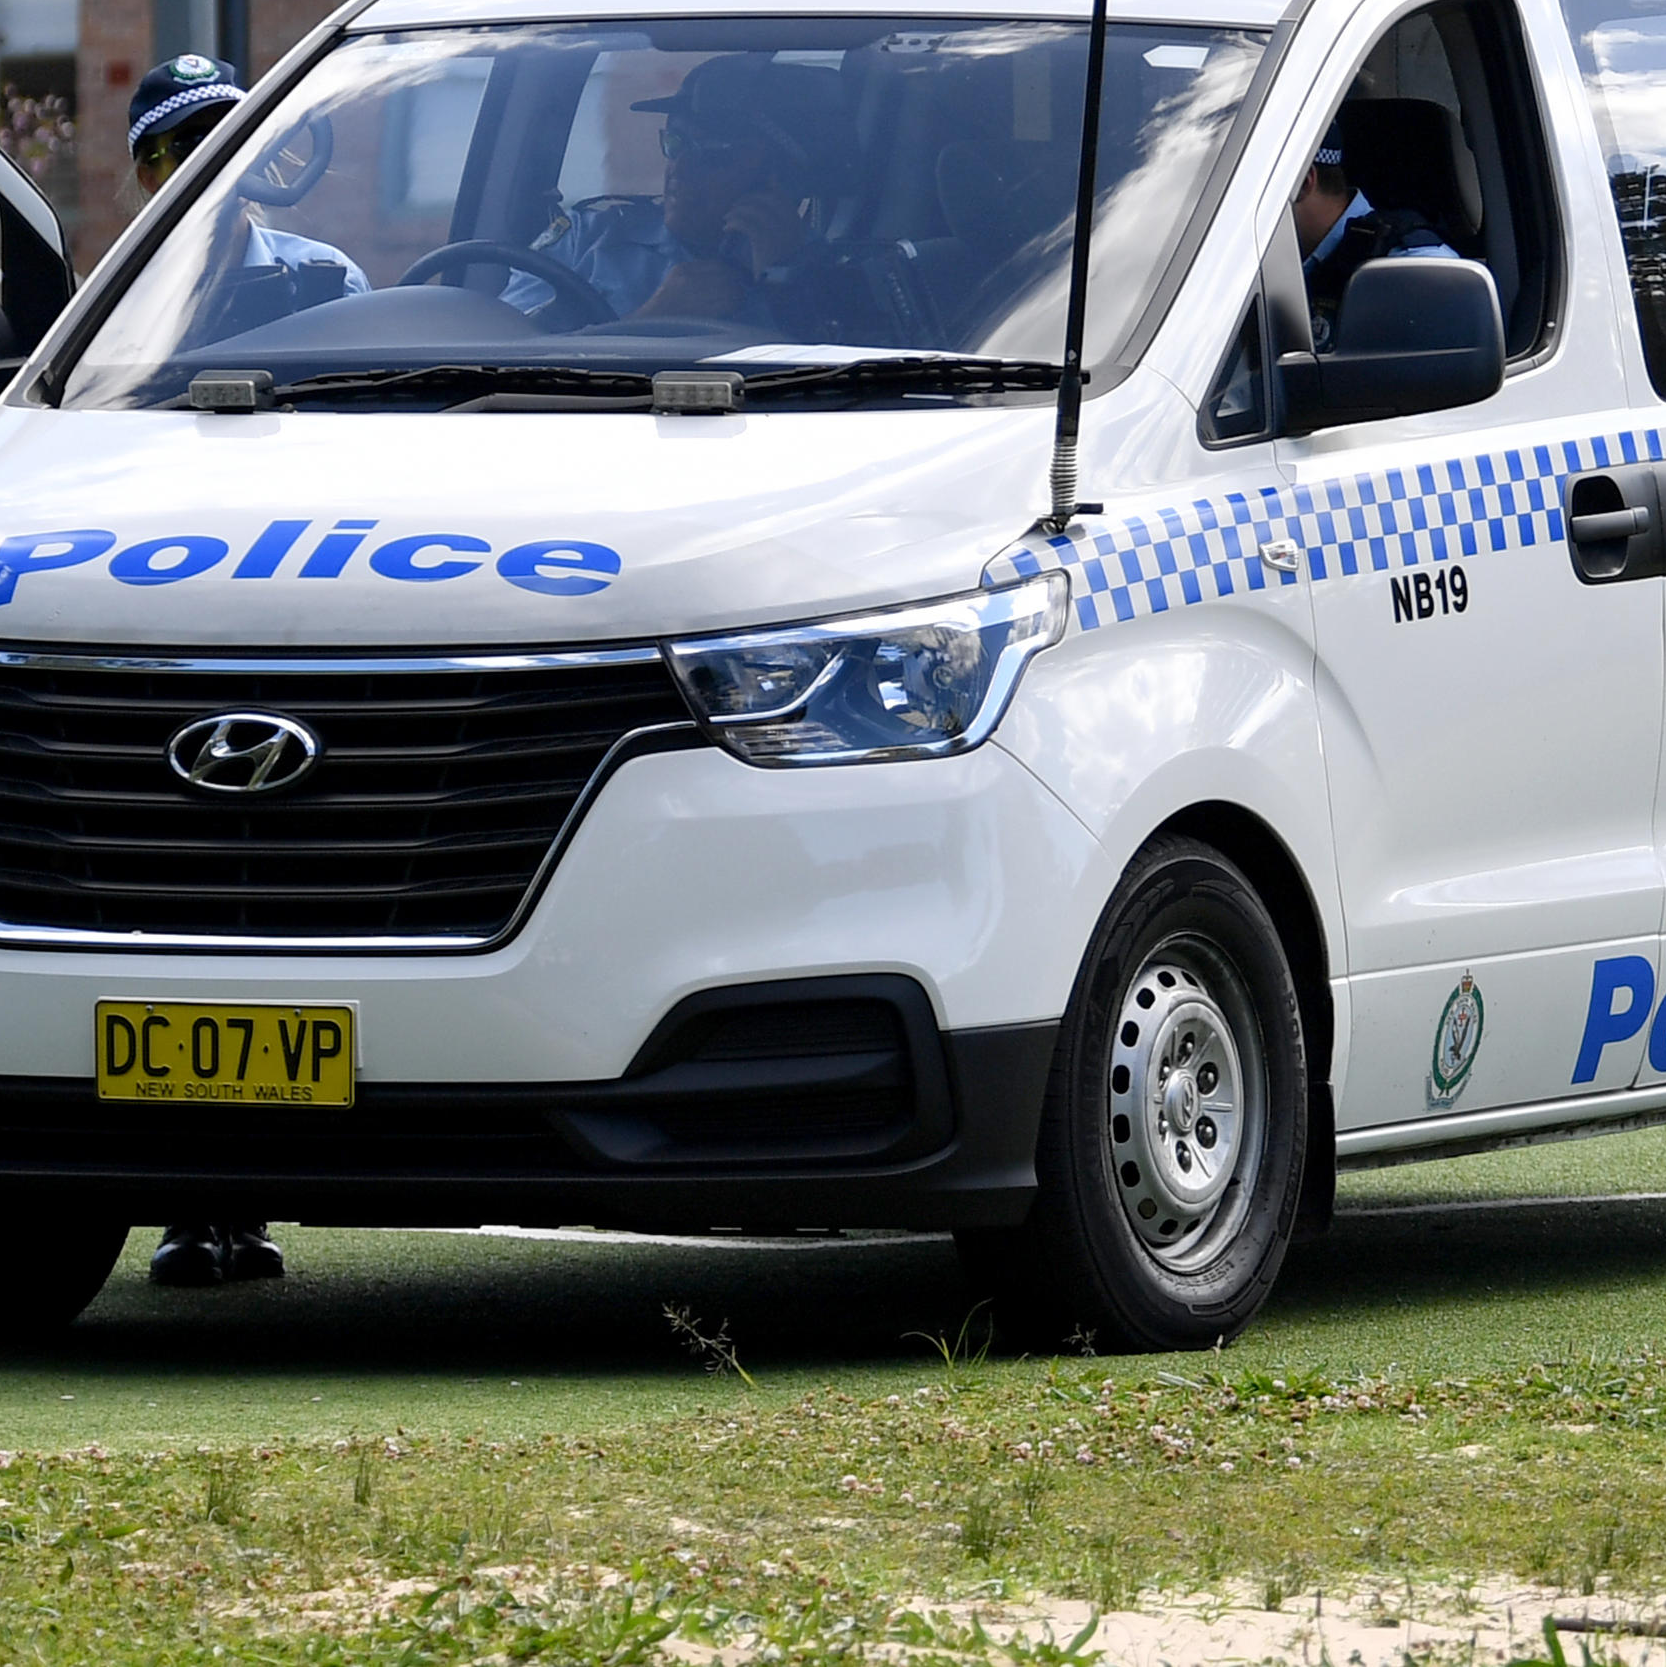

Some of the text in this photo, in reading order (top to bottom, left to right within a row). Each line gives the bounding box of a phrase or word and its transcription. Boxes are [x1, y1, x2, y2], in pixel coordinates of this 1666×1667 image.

[1390, 565, 1469, 624] NB19
[136, 1082, 313, 1101] NEW SOUTH WALES
